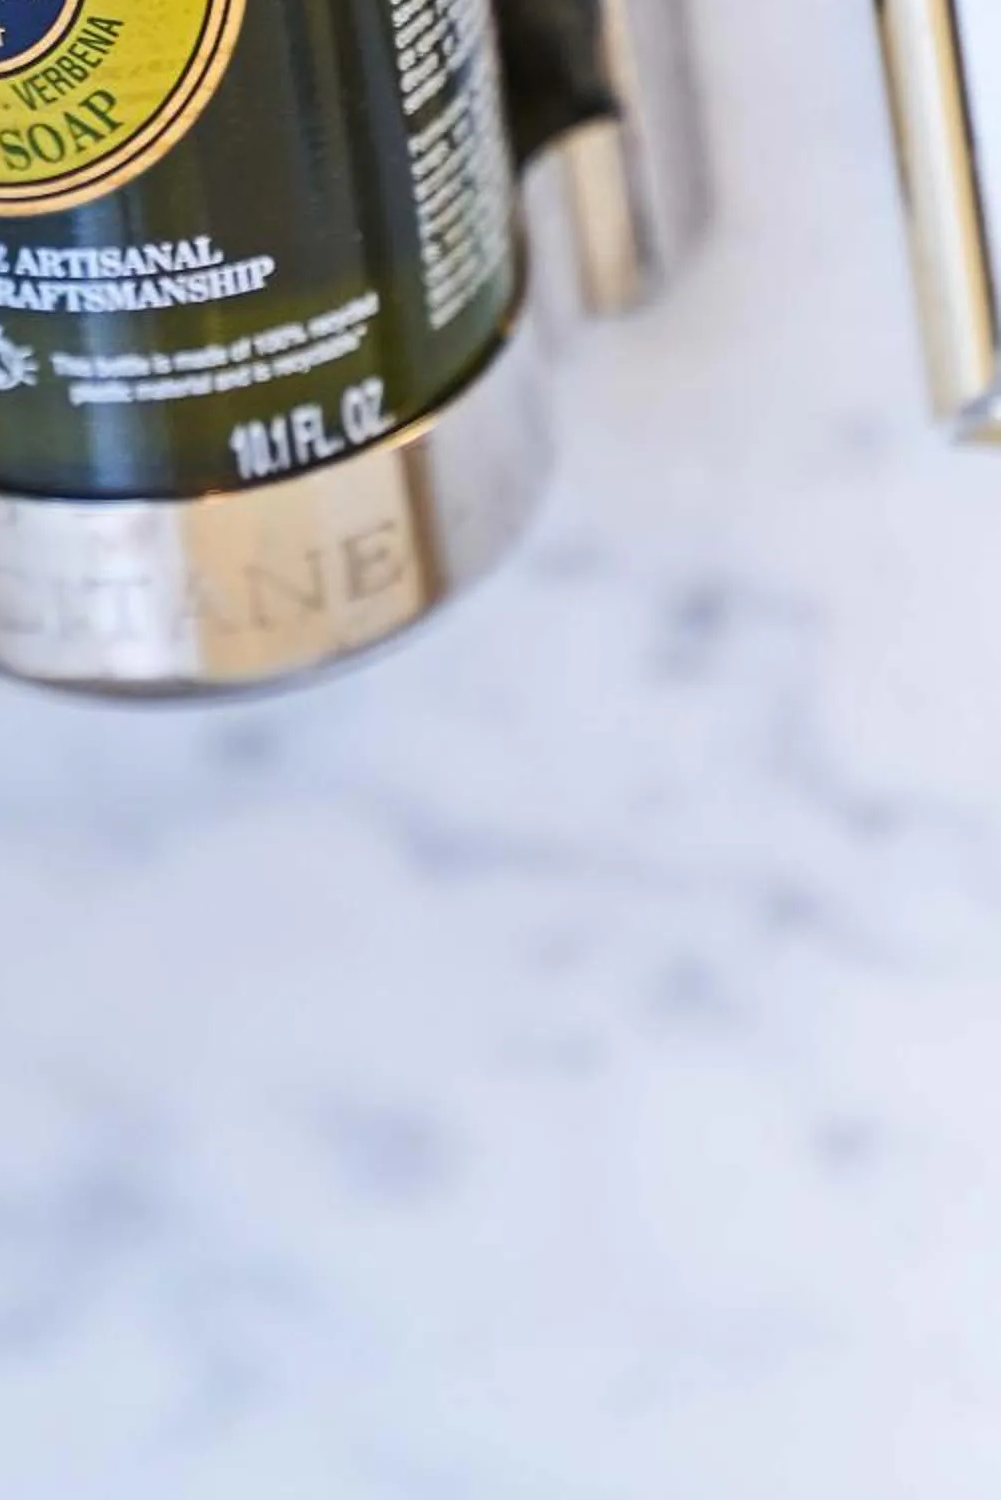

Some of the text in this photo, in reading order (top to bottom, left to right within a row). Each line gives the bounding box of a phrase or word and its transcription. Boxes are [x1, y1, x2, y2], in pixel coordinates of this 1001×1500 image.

[9, 13, 126, 113] VERBENA
[0, 88, 129, 173] SOAP
[14, 235, 224, 280] ARTISANAL
